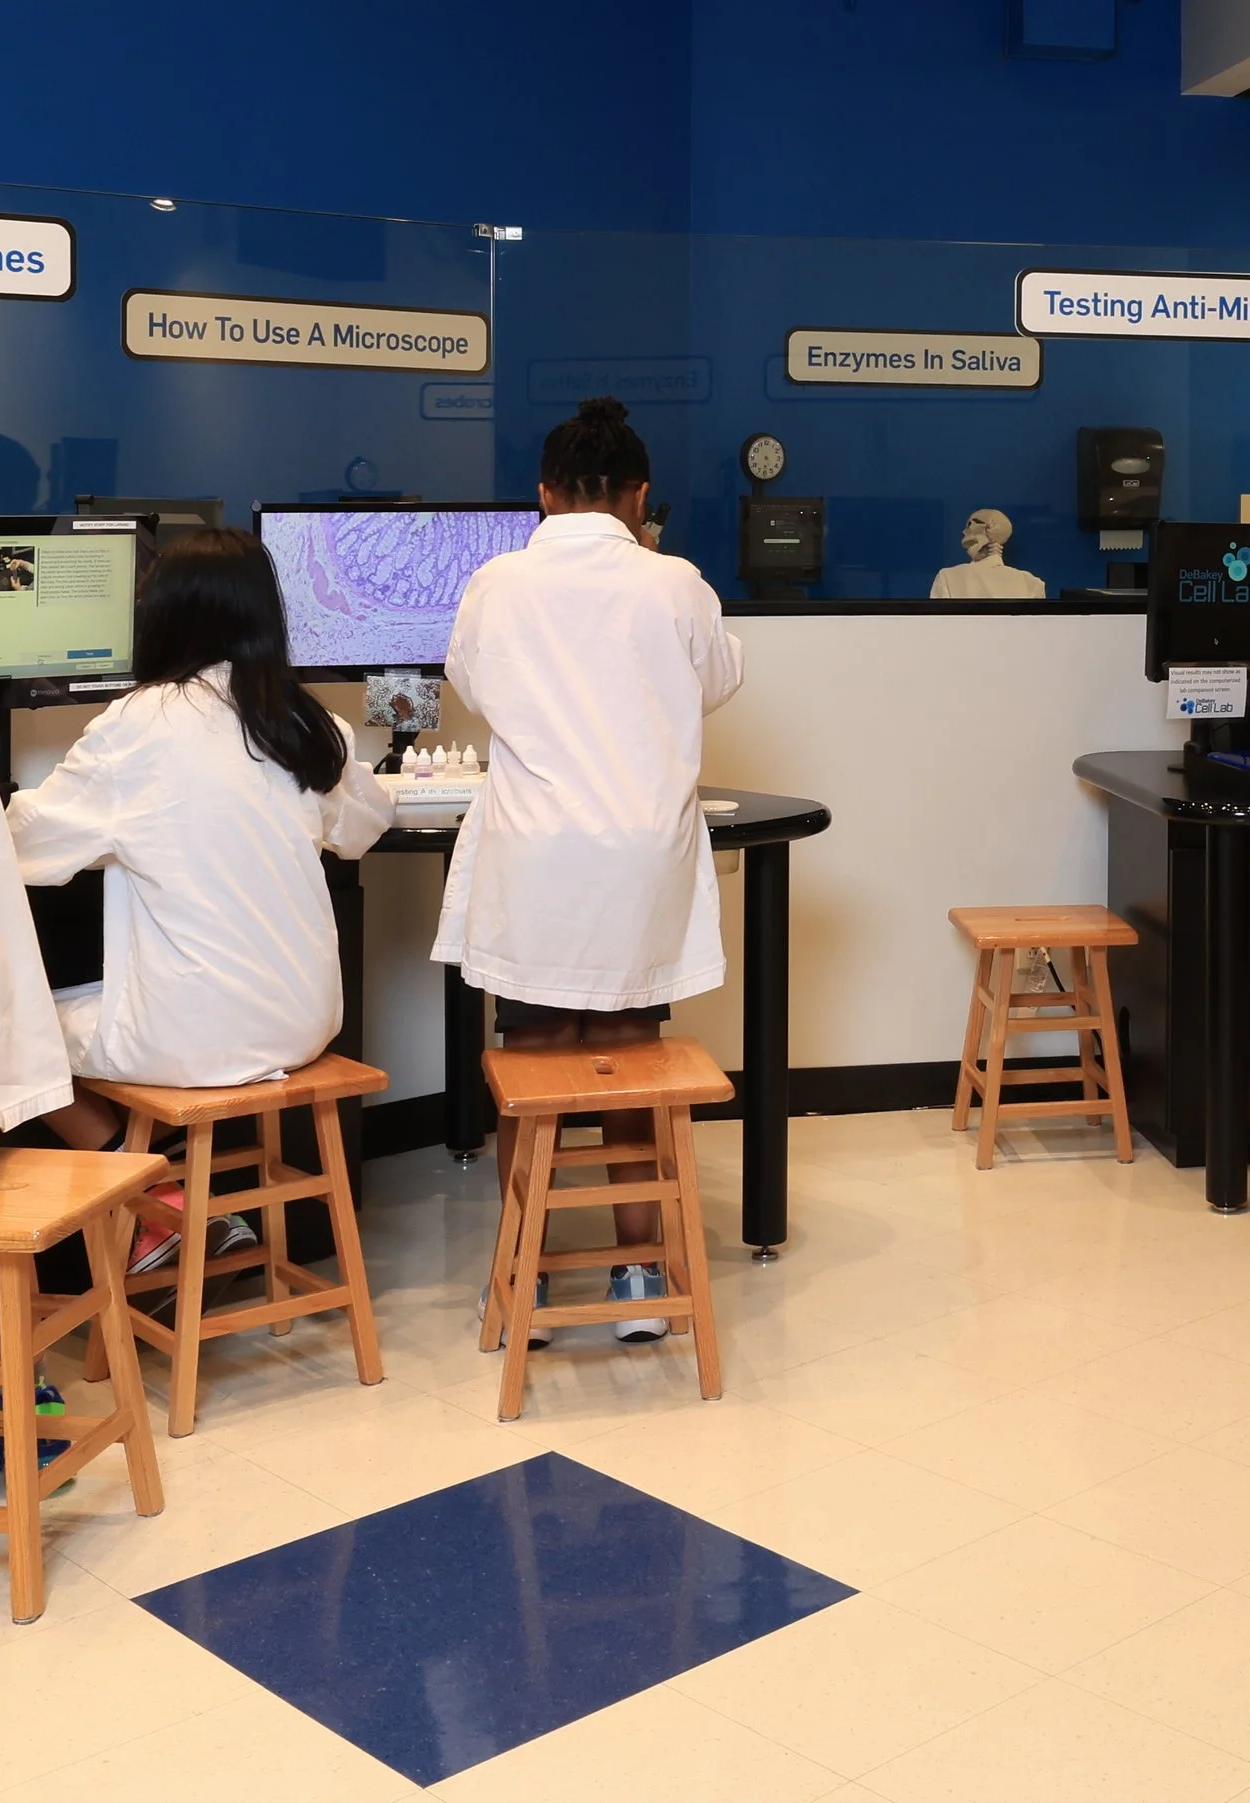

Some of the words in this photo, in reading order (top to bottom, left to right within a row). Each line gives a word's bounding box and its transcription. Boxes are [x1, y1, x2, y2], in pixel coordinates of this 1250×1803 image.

[1043, 290, 1143, 324] Testing
[1150, 293, 1250, 322] Anti-Mi
[148, 311, 208, 341] How
[214, 315, 245, 343] To
[252, 318, 301, 346] Use
[306, 322, 327, 347] A
[333, 323, 469, 359] Microscope
[807, 345, 916, 373] Enzymes
[923, 349, 944, 370] In
[951, 349, 1021, 372] Saliva
[1179, 569, 1223, 584] DeBakey
[1179, 580, 1216, 602] Cell
[1195, 703, 1213, 714] Cell
[1214, 702, 1233, 713] Lab
[395, 787, 418, 796] esting
